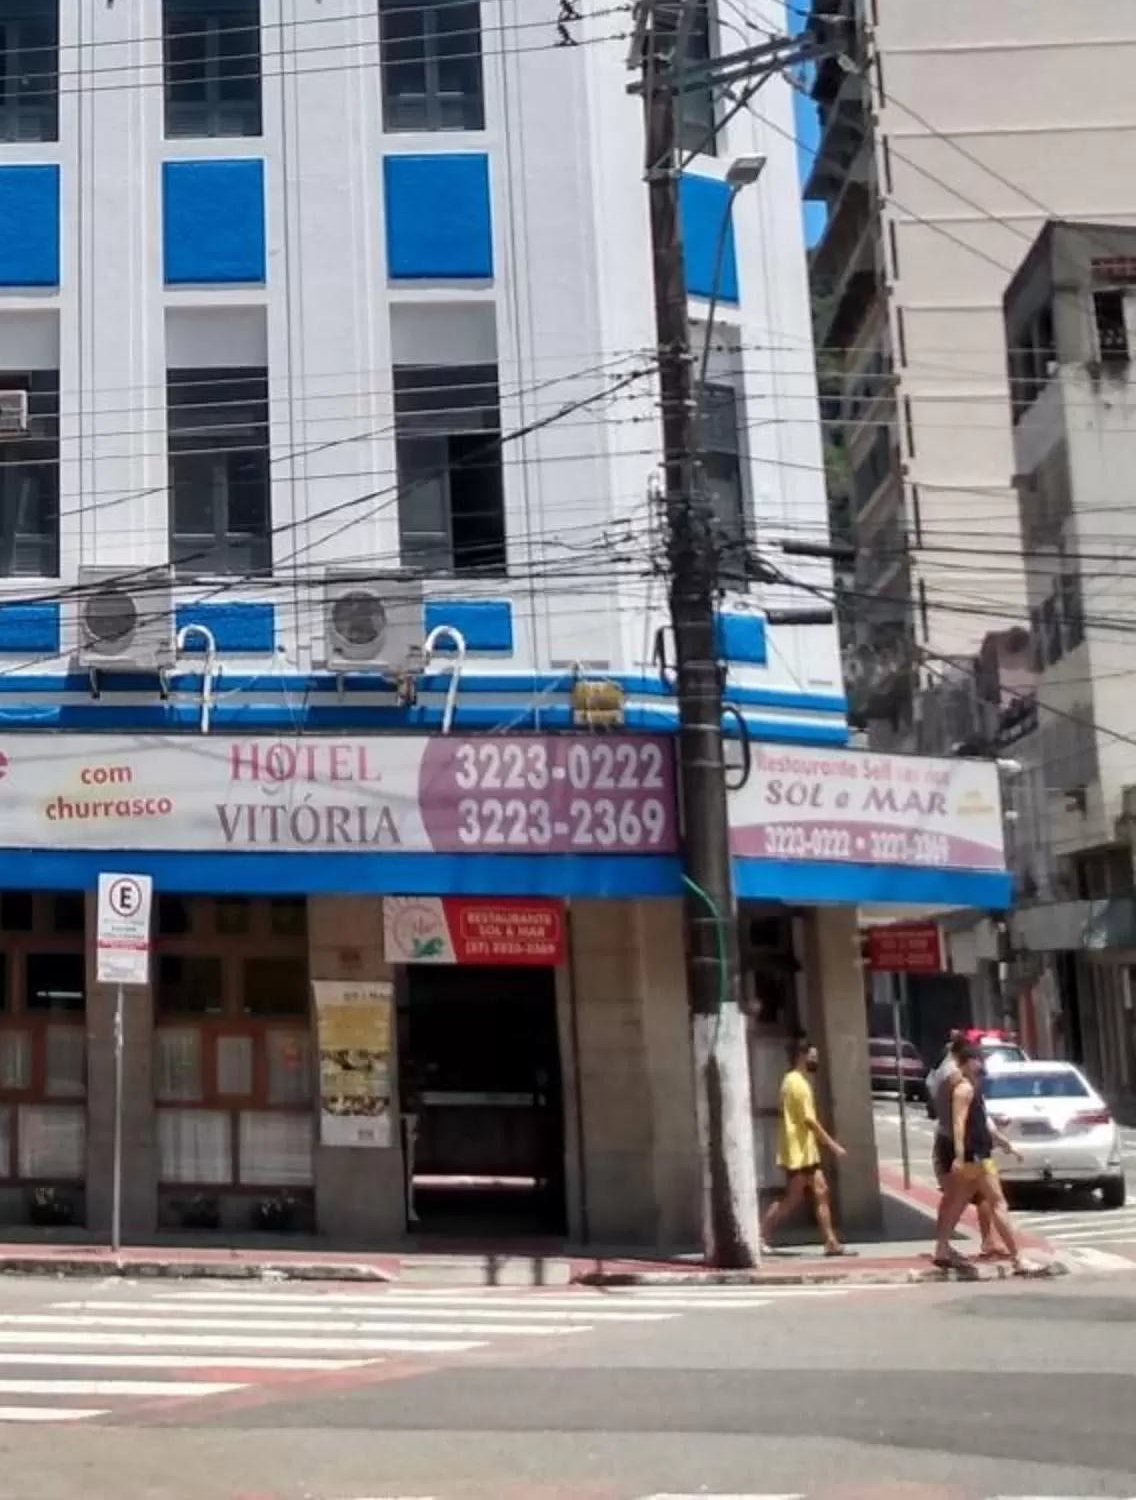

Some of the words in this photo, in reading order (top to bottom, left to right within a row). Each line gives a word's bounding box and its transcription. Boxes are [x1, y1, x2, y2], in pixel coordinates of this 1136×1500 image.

[80, 764, 133, 785] com
[231, 743, 382, 782] HOTEL
[455, 743, 663, 790] 3223-0222
[45, 795, 173, 820] churrasco
[765, 779, 824, 808] SOL
[863, 787, 949, 816] MAR
[215, 793, 402, 845] VITÓRIA
[458, 798, 665, 845] 3223-2369
[119, 886, 133, 909] E
